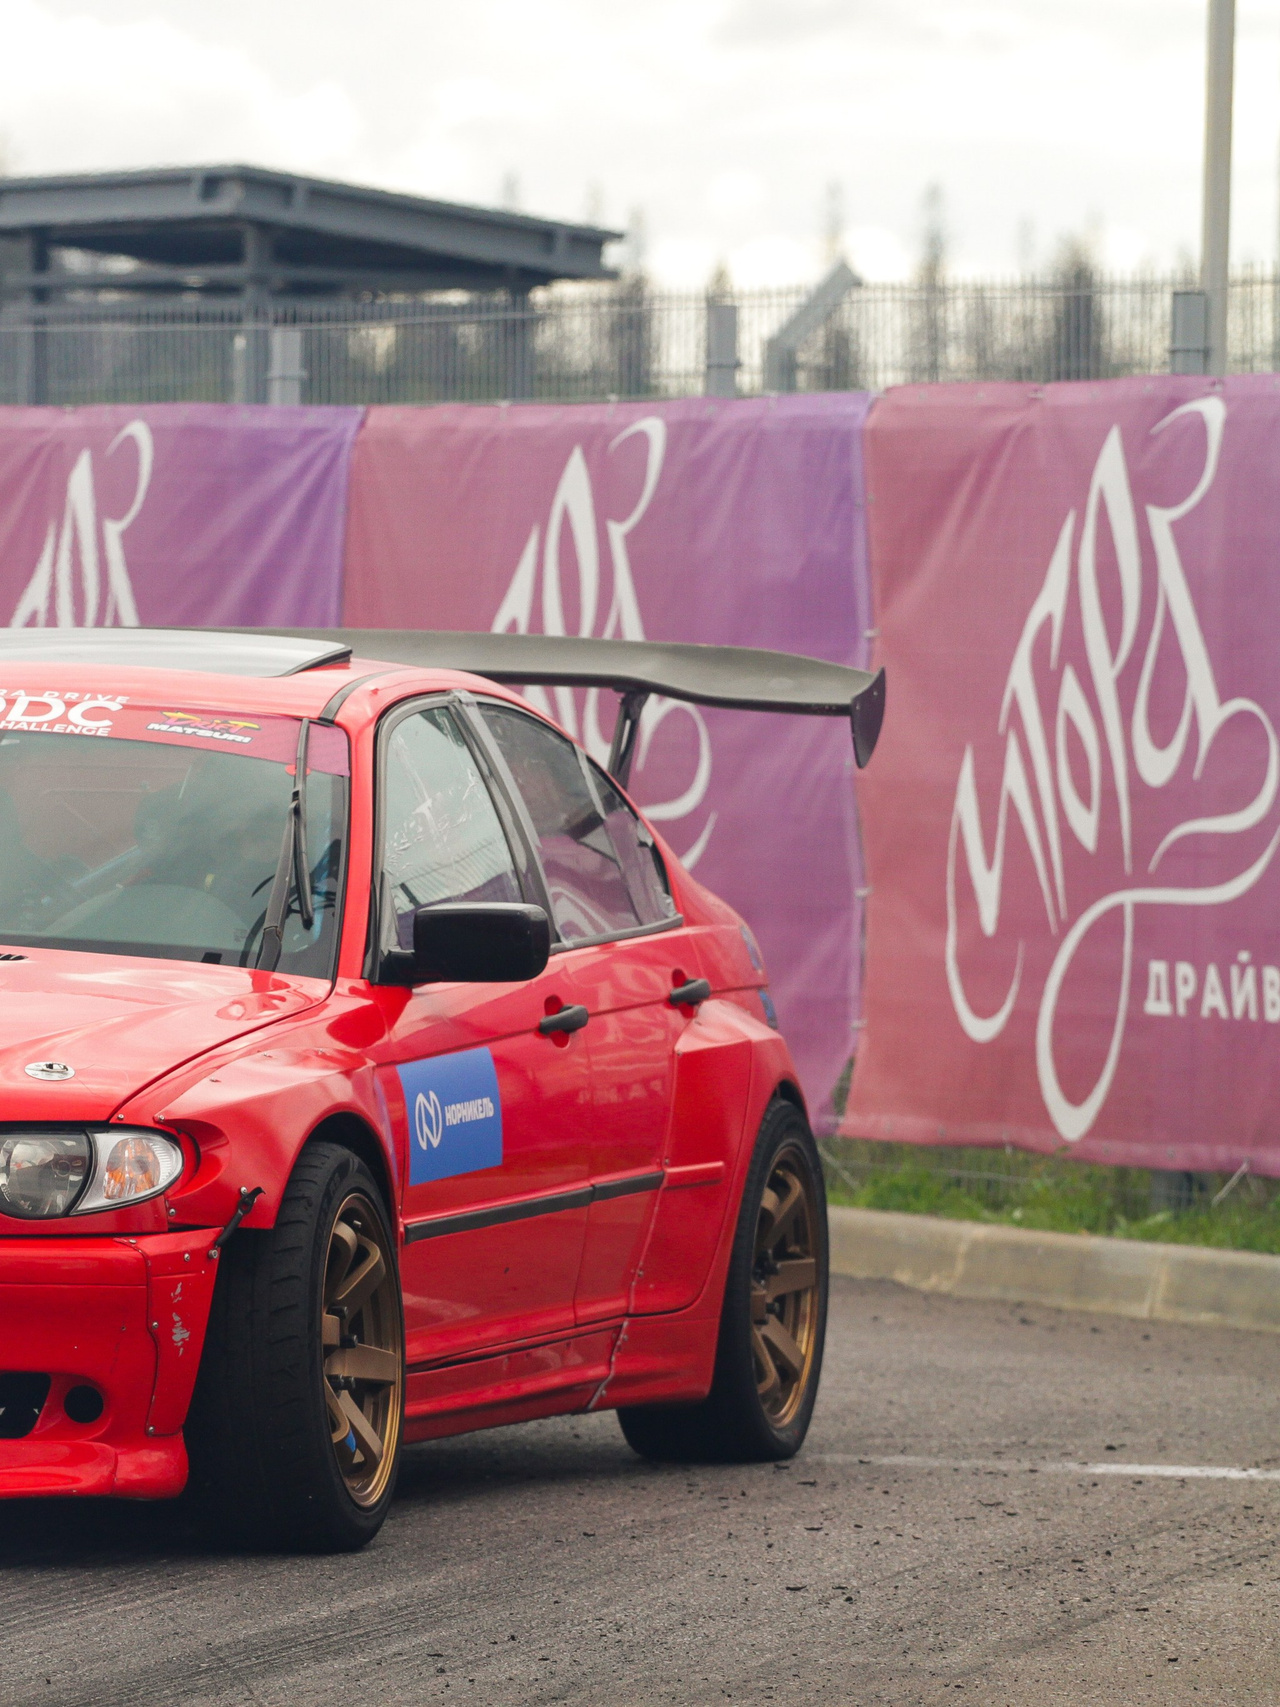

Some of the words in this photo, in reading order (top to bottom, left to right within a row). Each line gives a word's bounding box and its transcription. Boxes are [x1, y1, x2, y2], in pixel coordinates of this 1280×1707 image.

[43, 691, 130, 703] DRIVE
[146, 722, 254, 743] MATSURI
[1143, 950, 1280, 1022] ДРАЙВ
[444, 1096, 495, 1127] НОРНИКЕЛЬ
